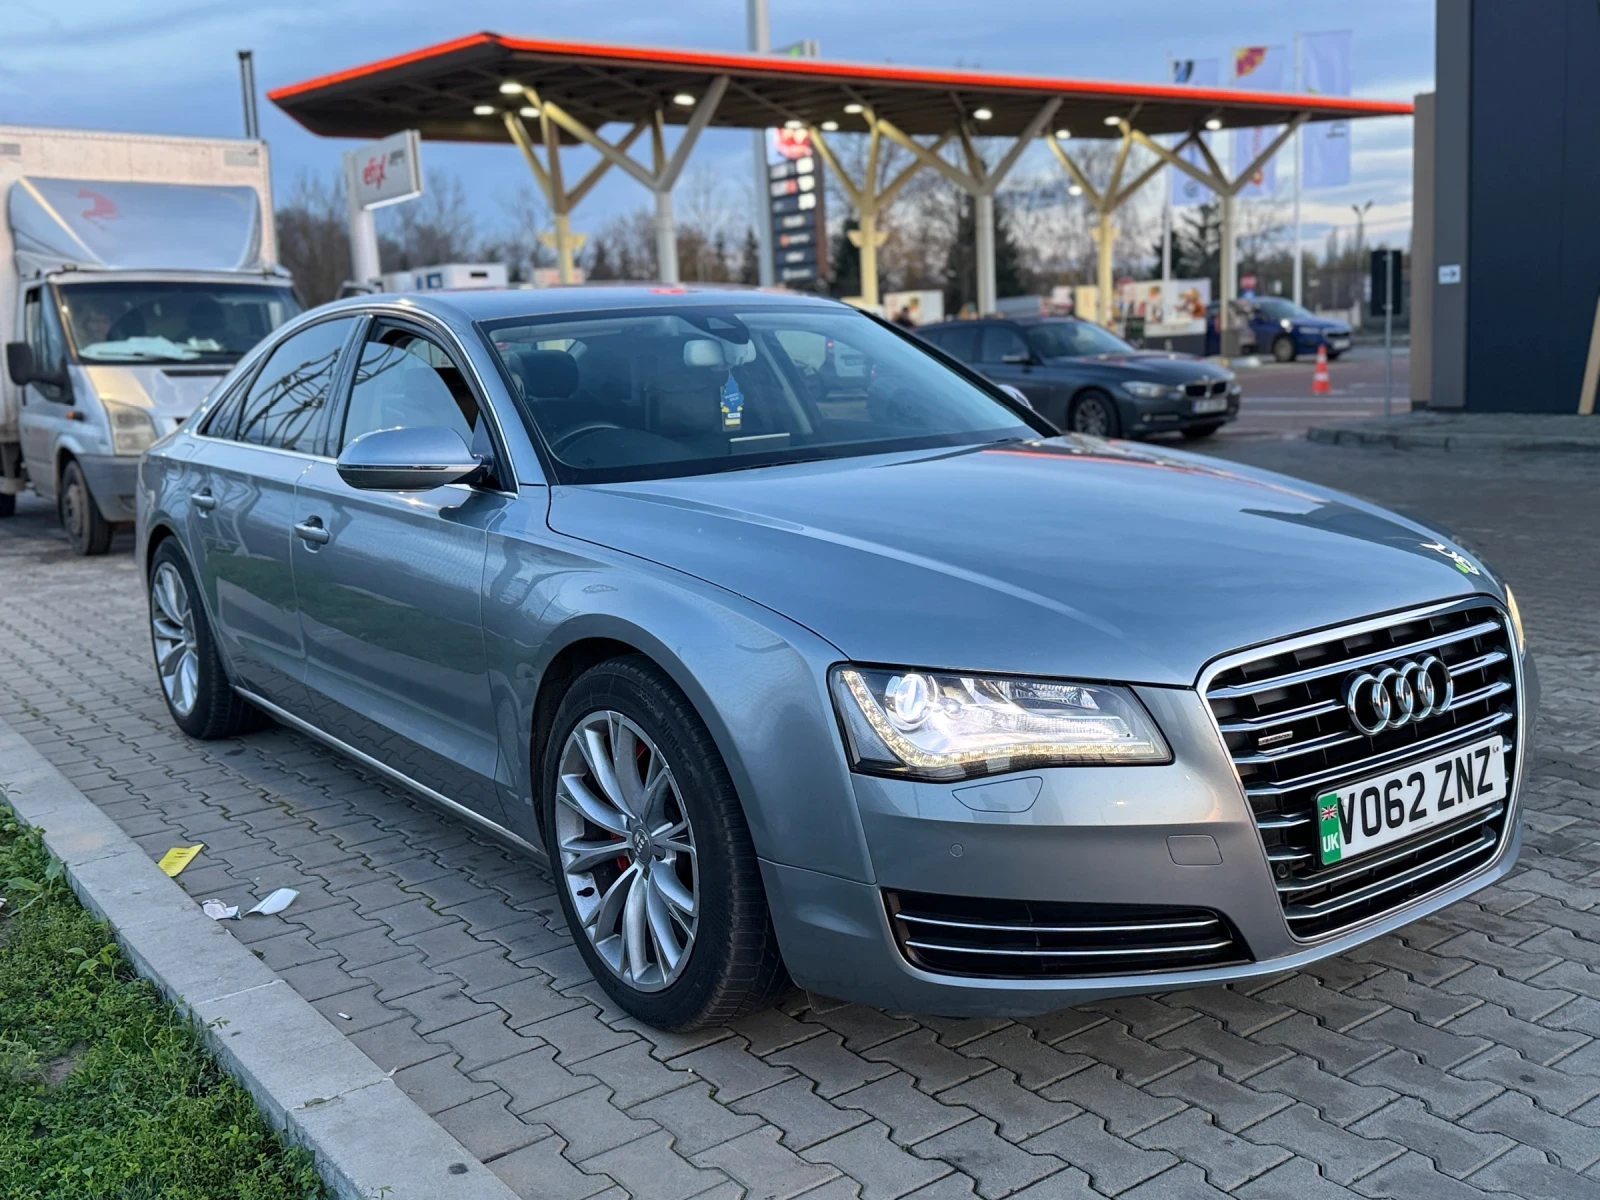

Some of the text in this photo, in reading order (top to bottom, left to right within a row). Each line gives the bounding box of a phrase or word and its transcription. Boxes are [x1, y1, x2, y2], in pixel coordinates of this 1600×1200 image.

[1337, 746, 1493, 845] VO62 ZNZ
[1322, 832, 1340, 853] UK
